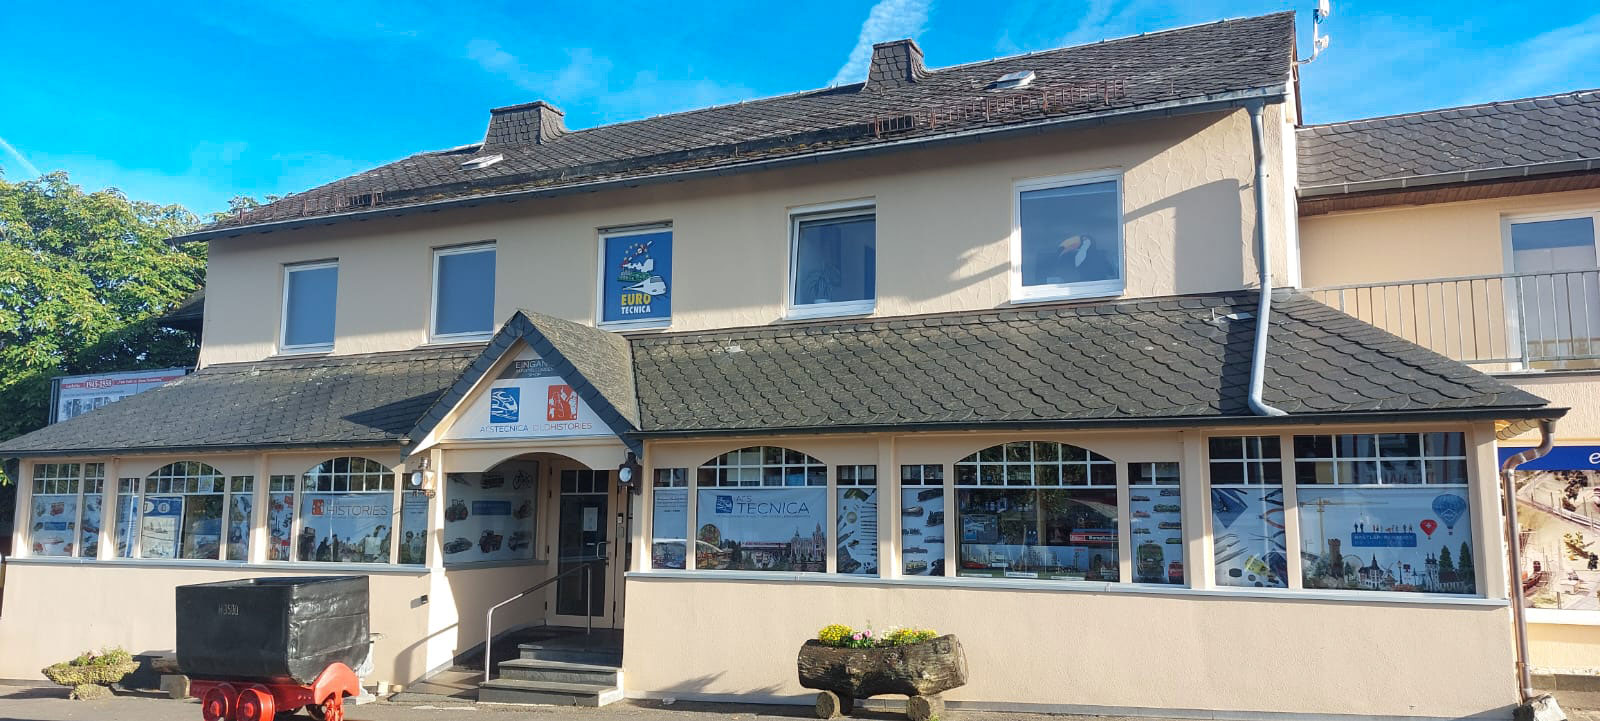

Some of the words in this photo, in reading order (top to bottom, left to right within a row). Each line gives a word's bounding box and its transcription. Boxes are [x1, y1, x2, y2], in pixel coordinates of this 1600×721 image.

[621, 293, 651, 306] EURO
[621, 306, 651, 314] TECNICA
[326, 505, 388, 516] HISTORIES
[736, 502, 810, 514] TECNICA
